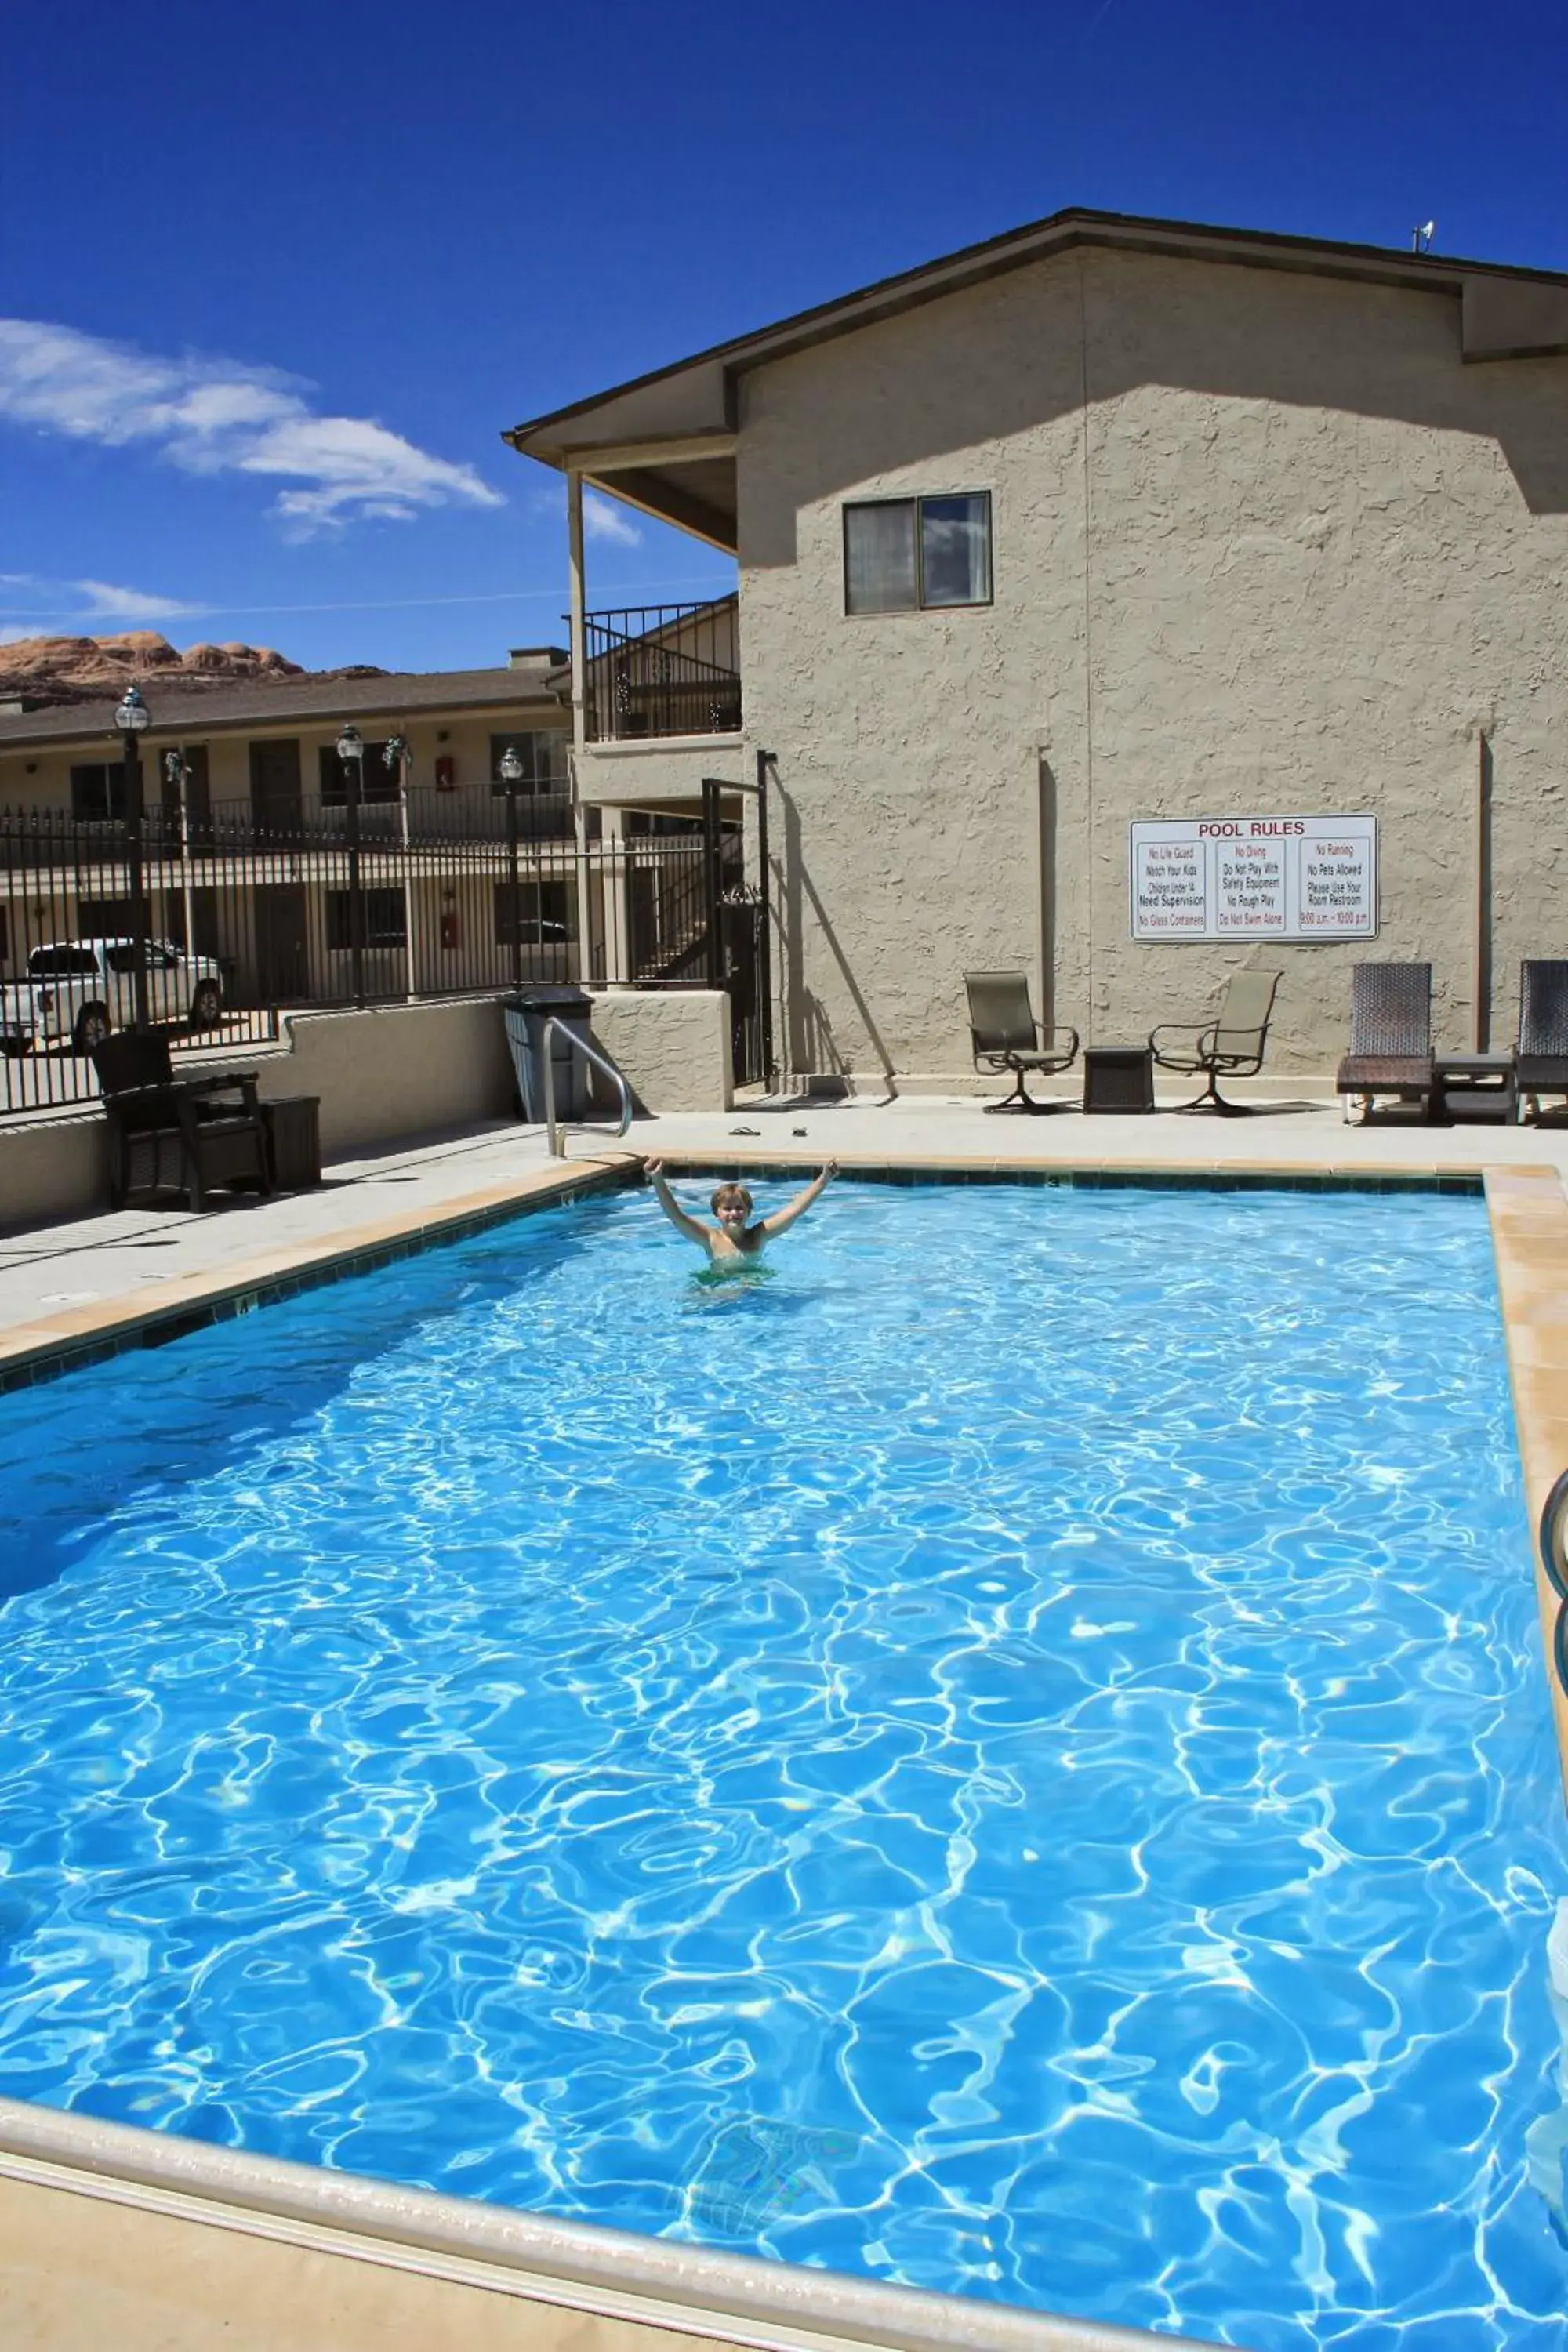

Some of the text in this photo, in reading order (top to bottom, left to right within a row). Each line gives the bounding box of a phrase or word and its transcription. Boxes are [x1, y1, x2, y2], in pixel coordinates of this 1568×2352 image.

[1199, 822, 1305, 837] POOL RULES
[1149, 847, 1159, 859] No
[1235, 845, 1266, 859] No Diving
[1316, 843, 1353, 858] No Running
[1167, 865, 1181, 876] Your
[1183, 865, 1196, 876] Kids
[1223, 863, 1233, 875] Do
[1235, 863, 1247, 875] Not
[1248, 862, 1261, 877] Play
[1308, 863, 1362, 876] No Pets Allowed
[1223, 877, 1243, 891] Safety
[1308, 881, 1361, 893] Please Use Your
[1140, 895, 1205, 908] Need Supervision
[1228, 895, 1274, 909] No Rough Play
[1308, 894, 1361, 906] Room Restroom
[1139, 914, 1204, 926] No Glass Containers
[1219, 913, 1228, 925] Do
[1230, 913, 1243, 924] Not
[1264, 913, 1283, 925] Alone
